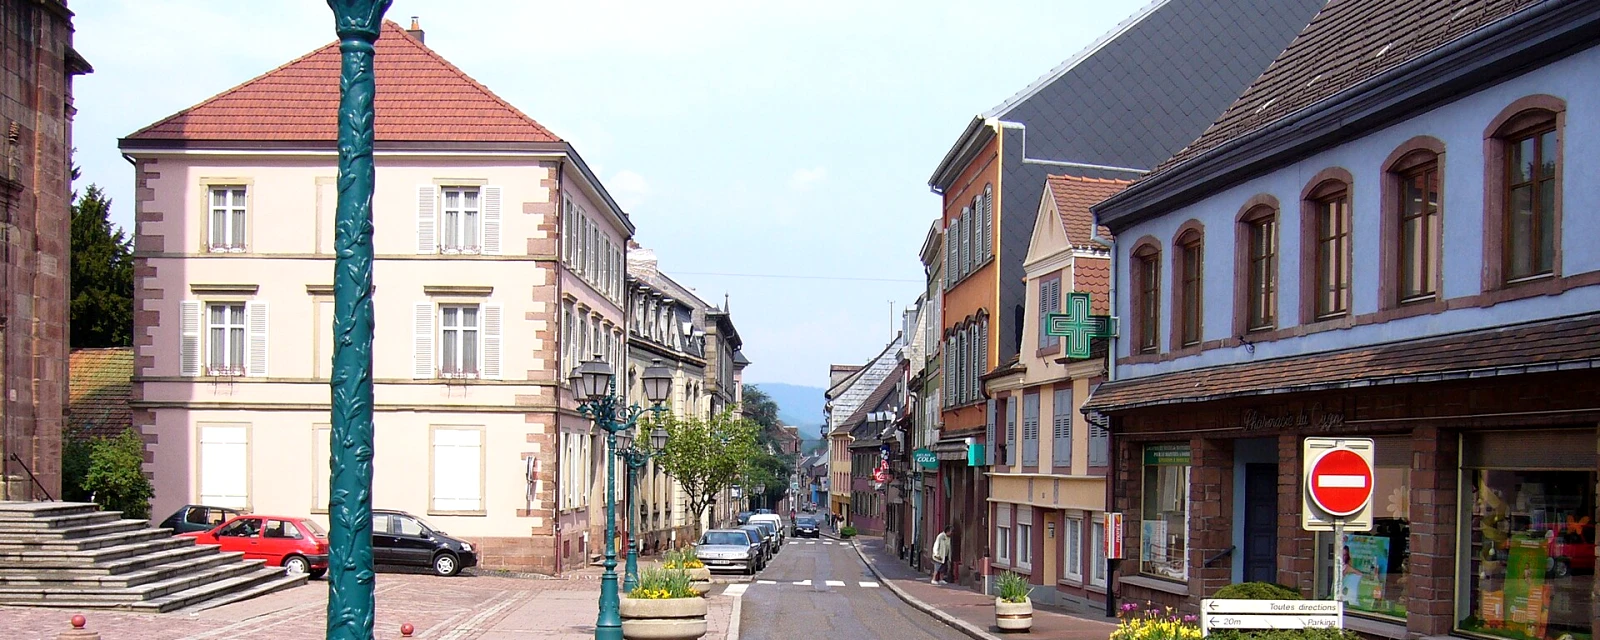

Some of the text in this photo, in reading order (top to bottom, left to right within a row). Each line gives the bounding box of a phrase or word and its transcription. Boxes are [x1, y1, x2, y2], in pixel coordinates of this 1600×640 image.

[1243, 402, 1344, 432] Pharmacie du Cygne
[1270, 603, 1336, 611] Toutes directions
[1307, 619, 1336, 627] Parking
